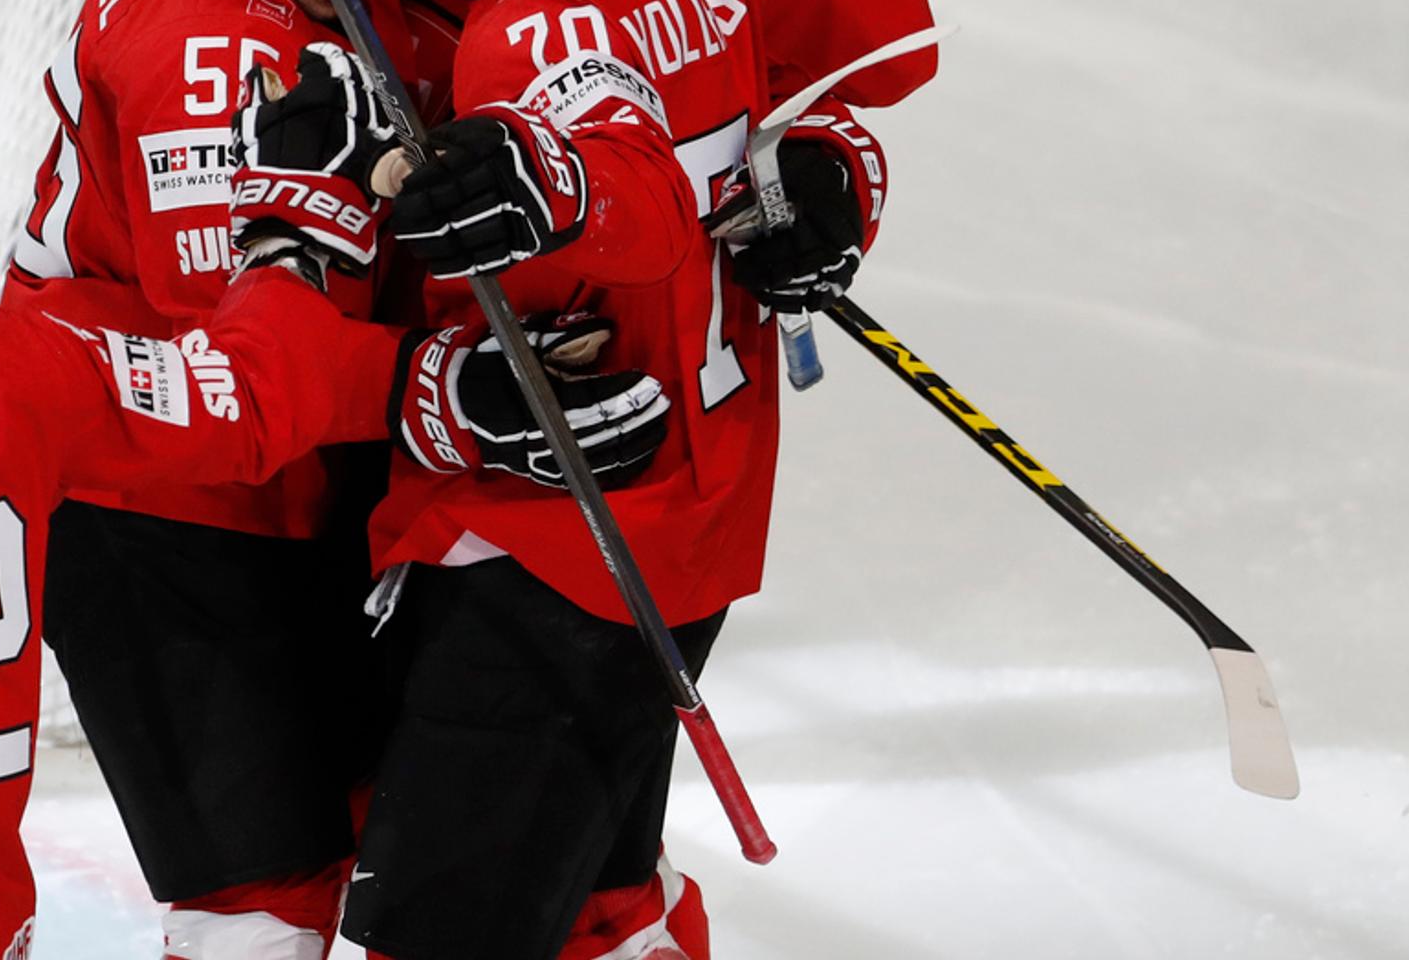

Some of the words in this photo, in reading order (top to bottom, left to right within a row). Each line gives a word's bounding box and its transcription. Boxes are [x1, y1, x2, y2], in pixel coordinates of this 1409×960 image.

[505, 3, 613, 75] 70
[547, 58, 659, 106] TISSOT
[153, 176, 184, 192] SWISS
[760, 183, 789, 229] BAUER
[158, 377, 171, 417] SWISS
[861, 329, 1065, 491] CCM
